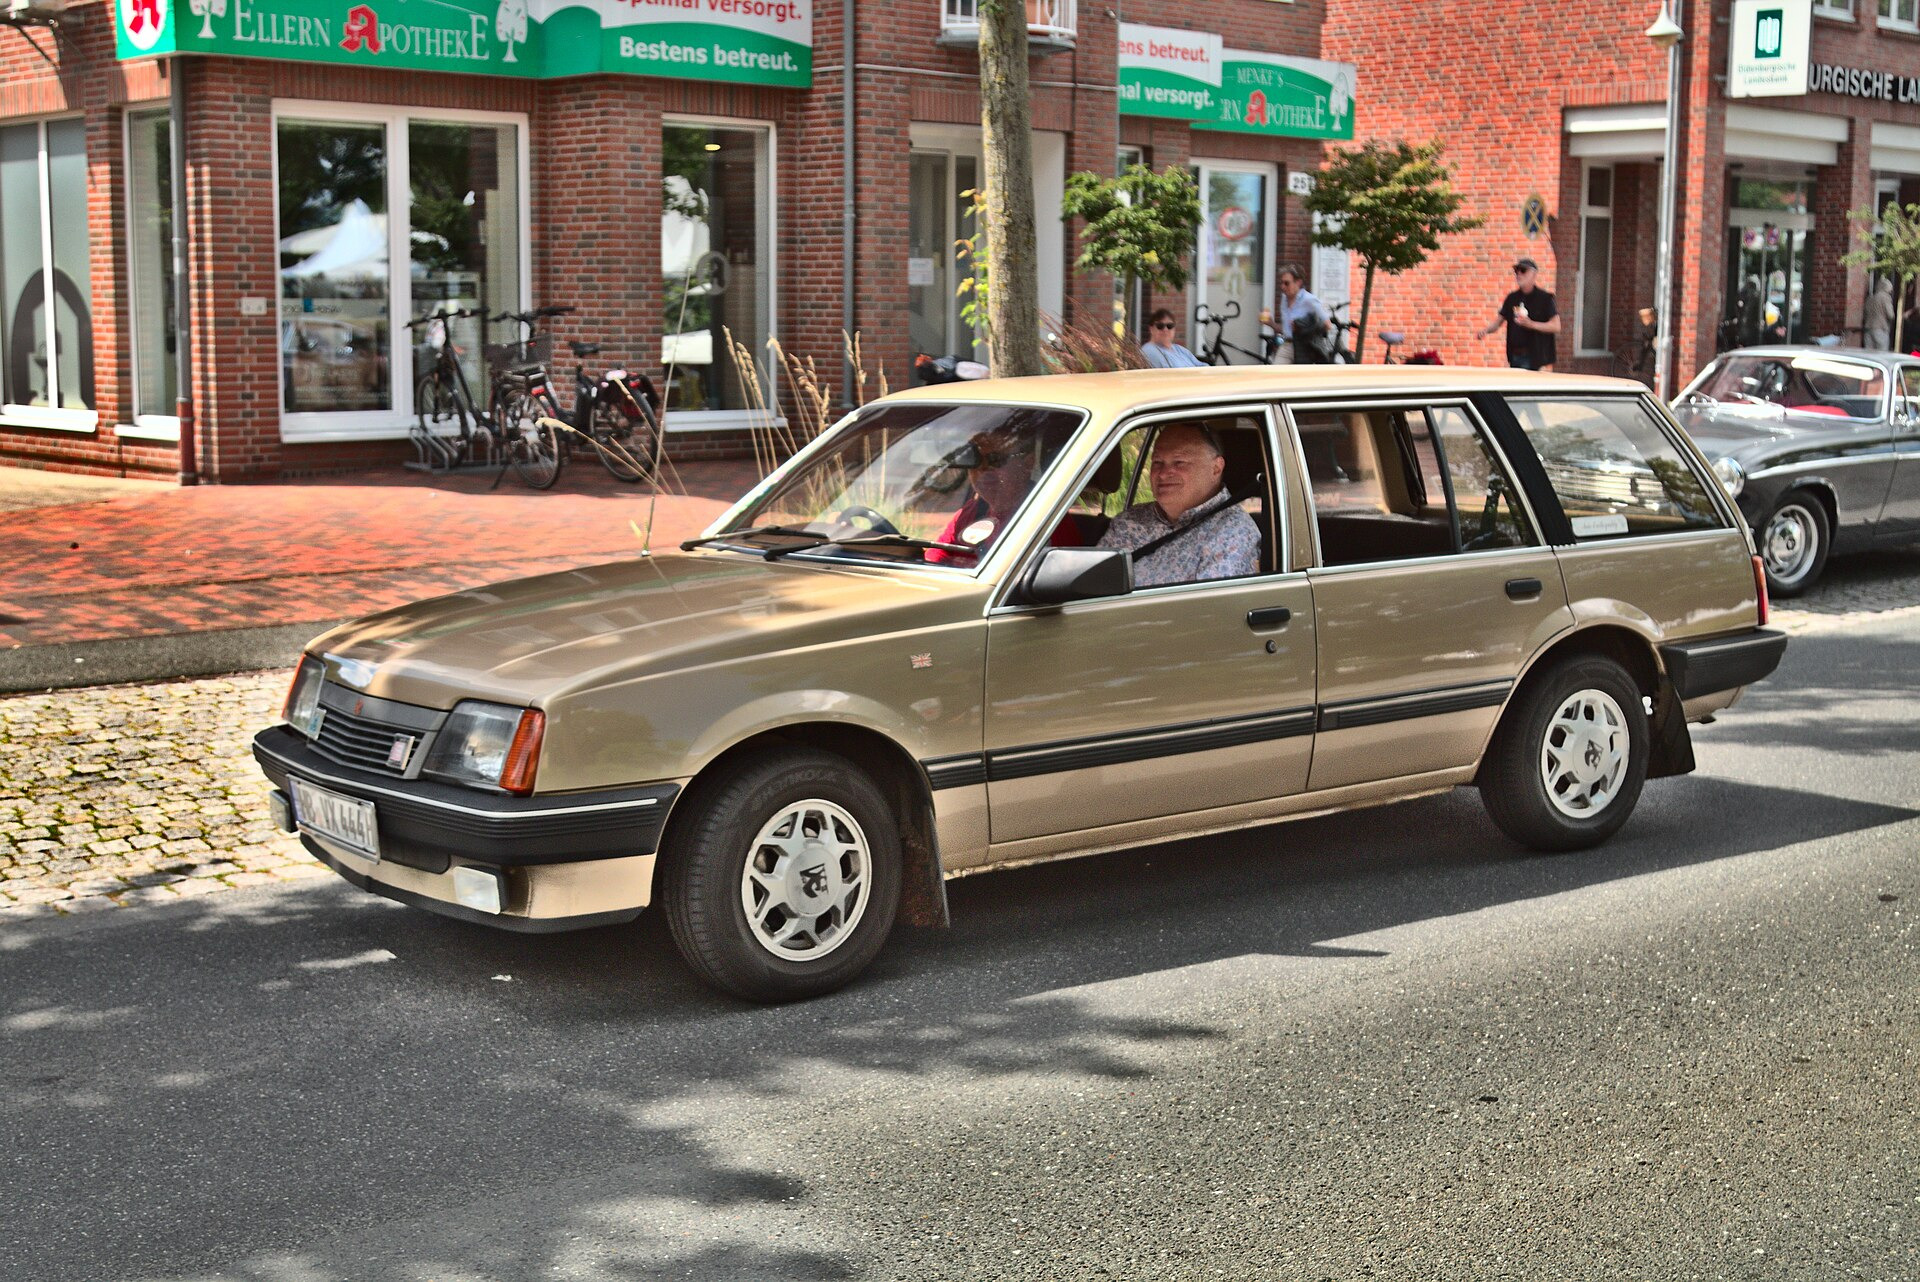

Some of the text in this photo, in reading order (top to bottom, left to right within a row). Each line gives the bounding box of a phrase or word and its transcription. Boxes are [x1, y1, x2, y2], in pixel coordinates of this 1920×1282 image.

[619, 35, 798, 72] Bestens betreut.
[1149, 39, 1210, 63] betreut.
[1144, 85, 1215, 111] versorgt.
